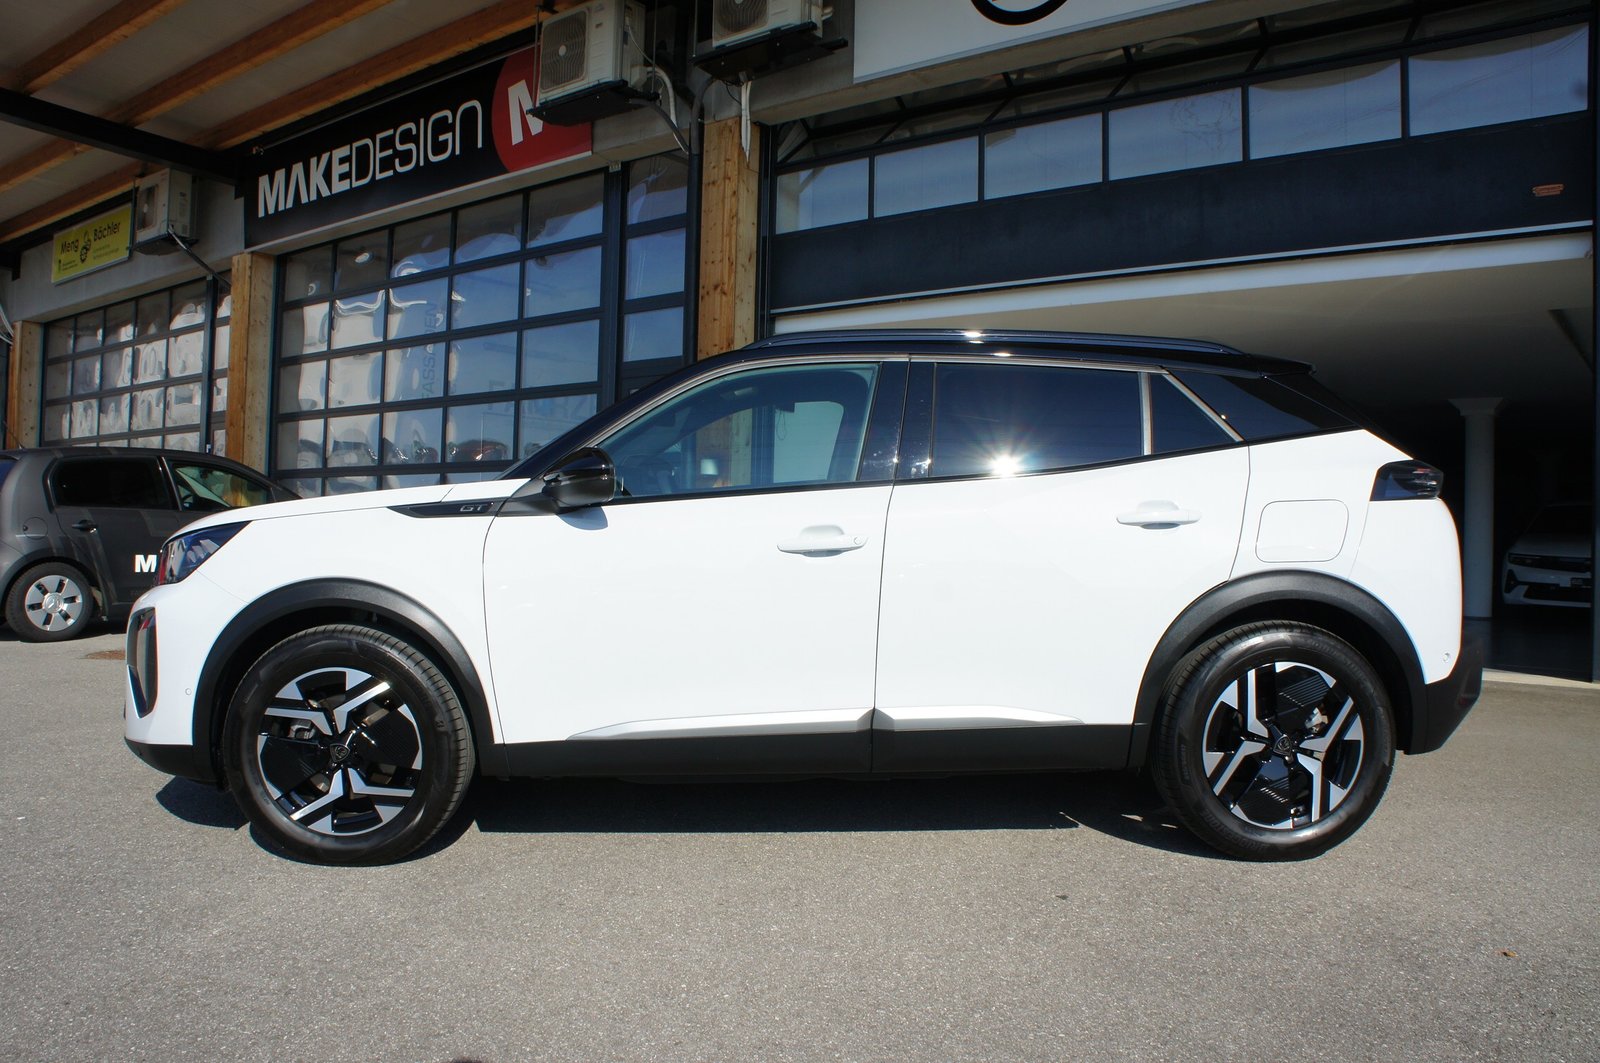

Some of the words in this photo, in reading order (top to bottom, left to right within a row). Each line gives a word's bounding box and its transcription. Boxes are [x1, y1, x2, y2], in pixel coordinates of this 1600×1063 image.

[60, 239, 79, 254] Meng
[459, 503, 488, 512] GT
[134, 554, 158, 573] M
